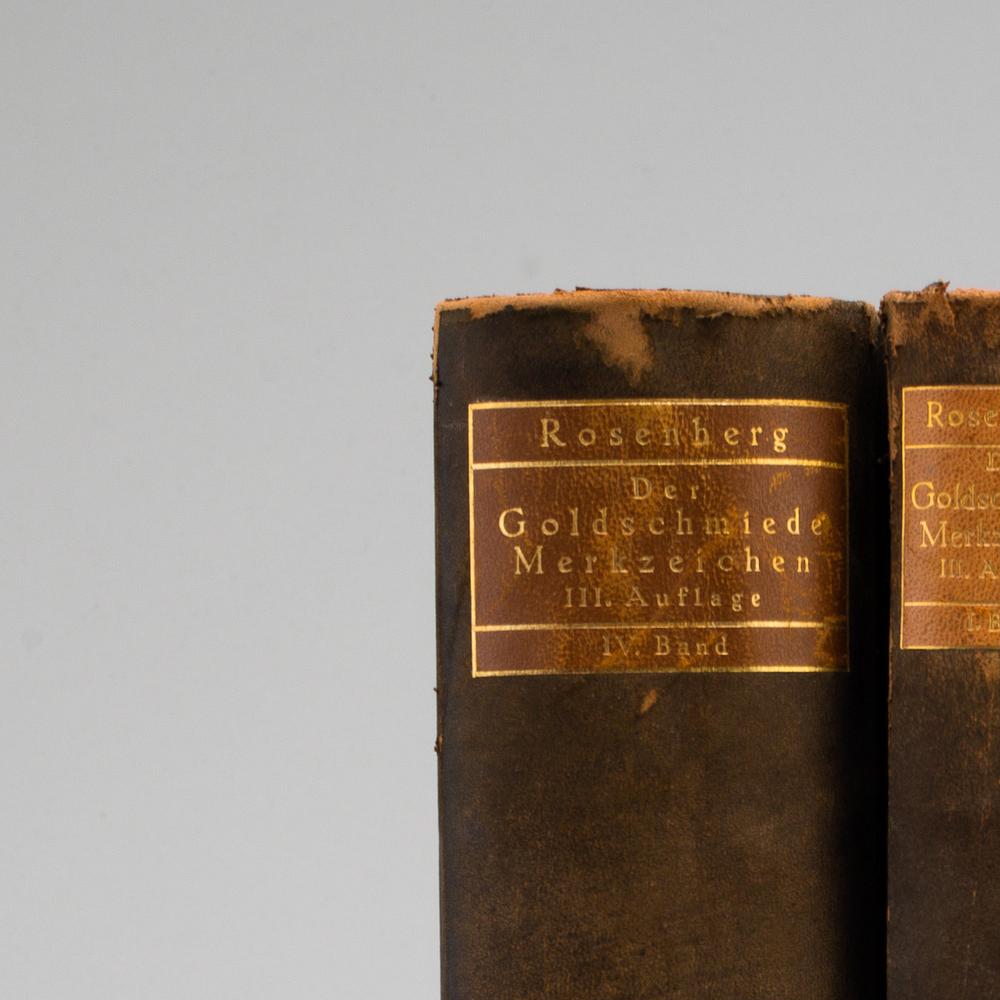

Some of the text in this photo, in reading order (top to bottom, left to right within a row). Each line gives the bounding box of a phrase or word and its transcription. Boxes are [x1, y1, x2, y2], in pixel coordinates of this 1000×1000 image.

[540, 418, 789, 453] Rosenberg
[631, 477, 699, 500] Der
[498, 507, 823, 537] Goldschmiede
[514, 545, 810, 575] Merkzeichen
[565, 587, 761, 612] III. Auflage
[655, 635, 729, 656] Band
